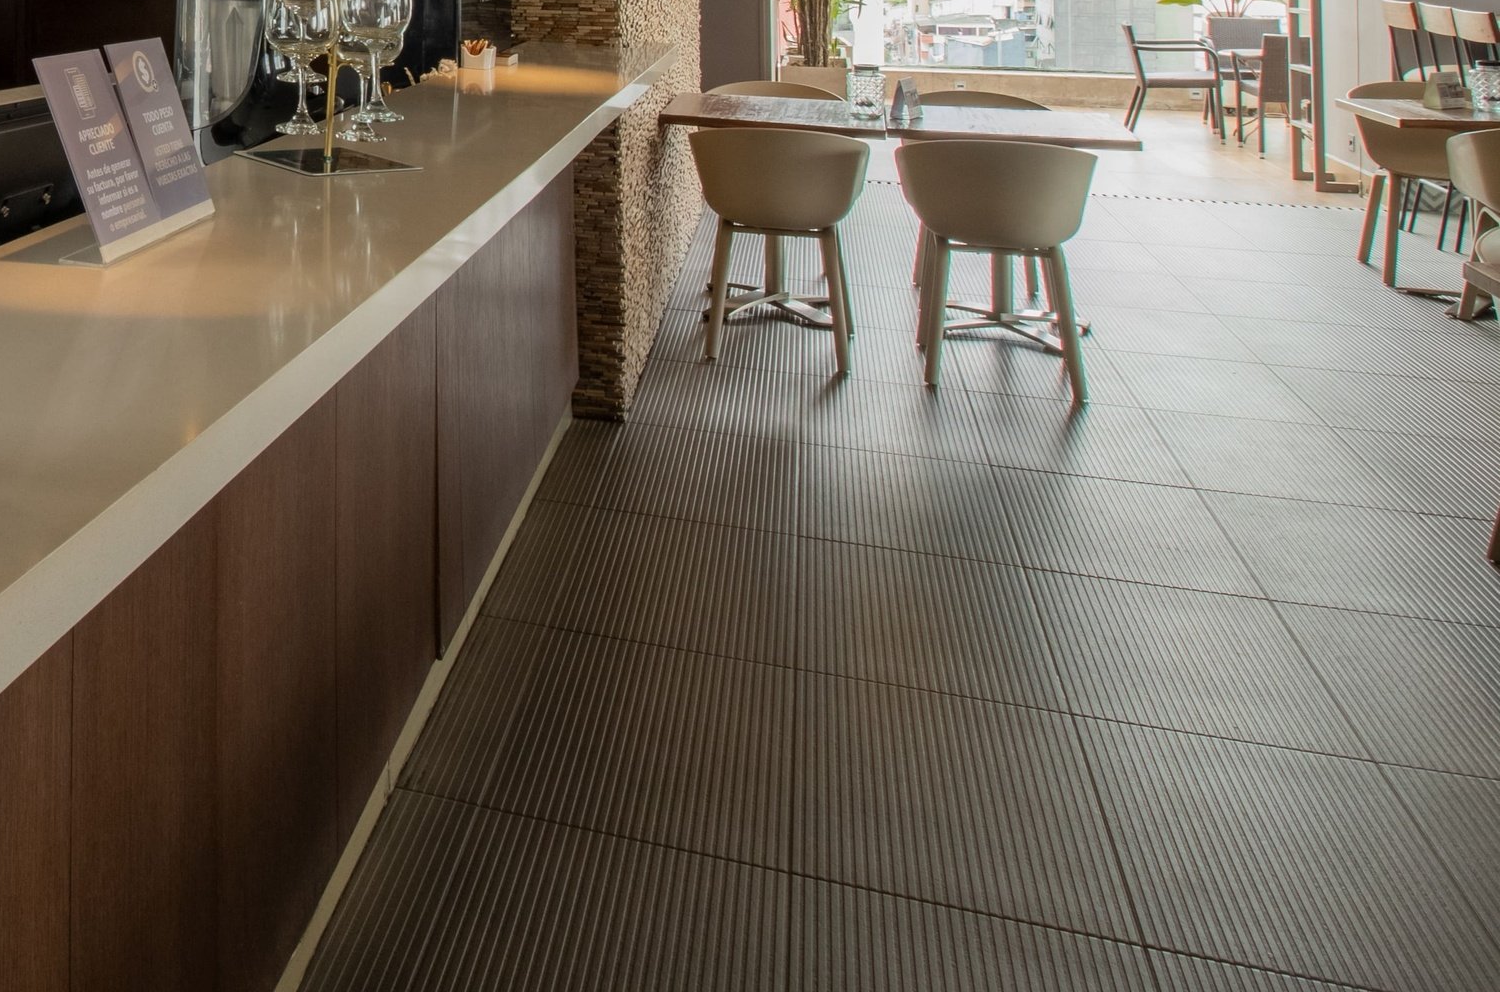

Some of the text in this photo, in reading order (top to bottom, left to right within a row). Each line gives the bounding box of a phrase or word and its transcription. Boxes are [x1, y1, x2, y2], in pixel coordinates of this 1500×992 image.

[142, 106, 174, 124] TODO PESO
[78, 122, 115, 143] APRECIADO
[152, 121, 175, 136] CUENTA
[89, 138, 115, 155] CLIENTE
[86, 158, 132, 180] Antes de generar
[86, 185, 94, 195] su
[115, 175, 124, 187] por
[123, 169, 139, 182] favor
